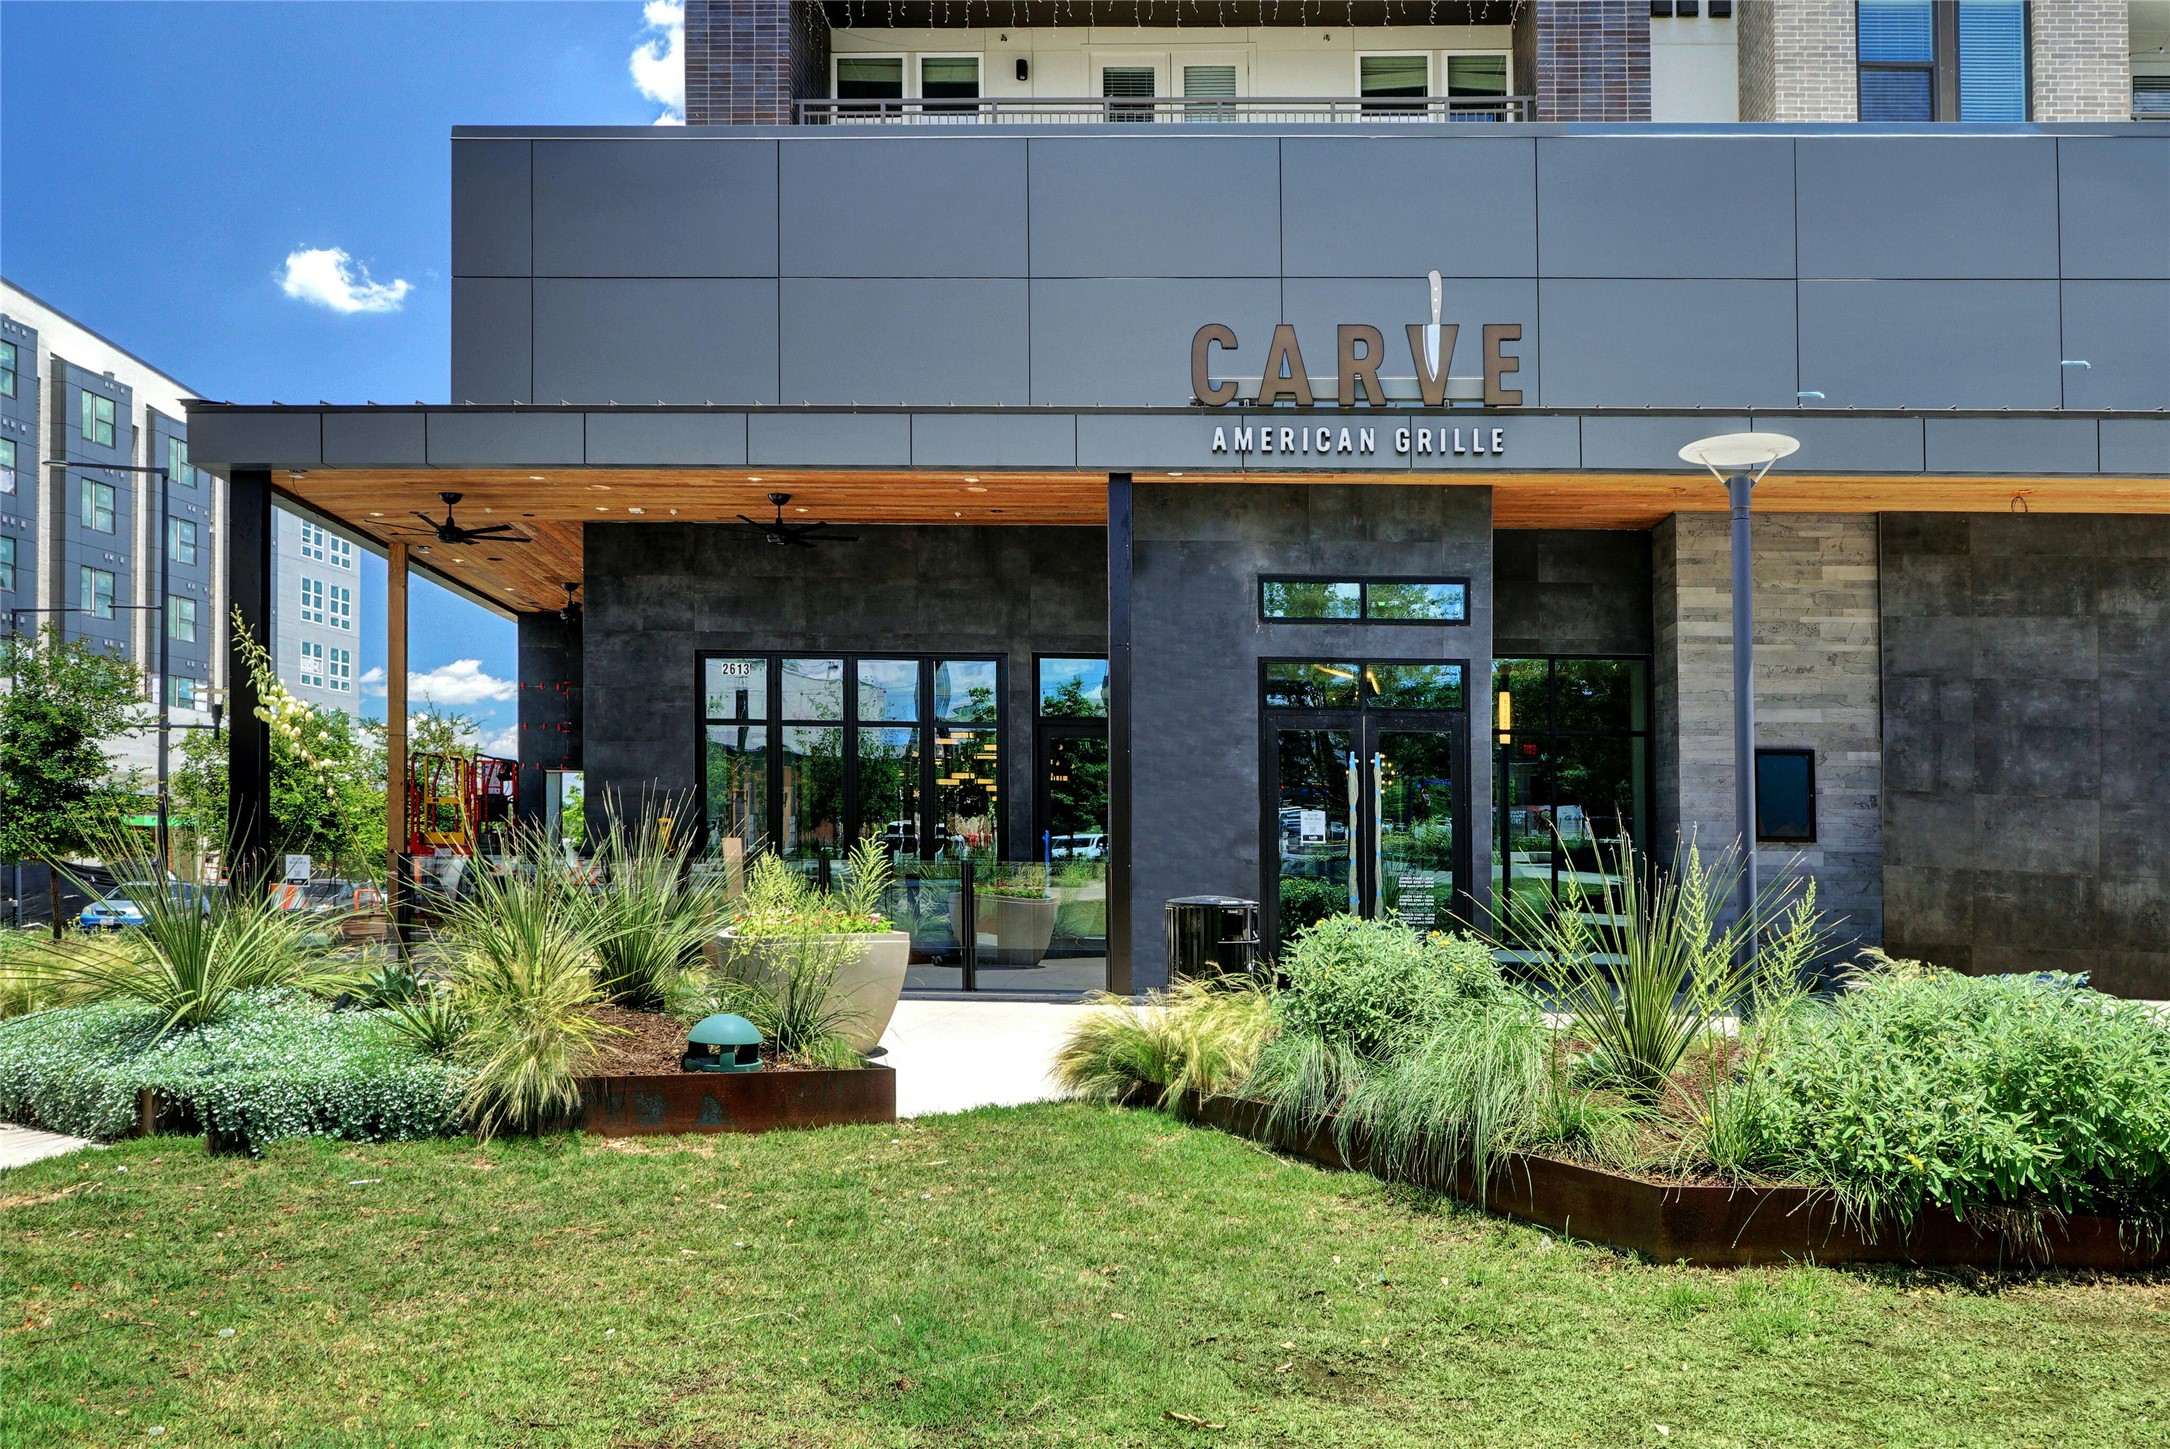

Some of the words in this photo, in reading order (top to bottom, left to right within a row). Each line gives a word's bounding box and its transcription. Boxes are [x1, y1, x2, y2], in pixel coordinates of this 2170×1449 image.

[1191, 323, 1522, 406] CARVE
[1212, 426, 1375, 454] AMERICAN
[1395, 427, 1504, 455] GRILLE
[722, 663, 750, 675] 2613
